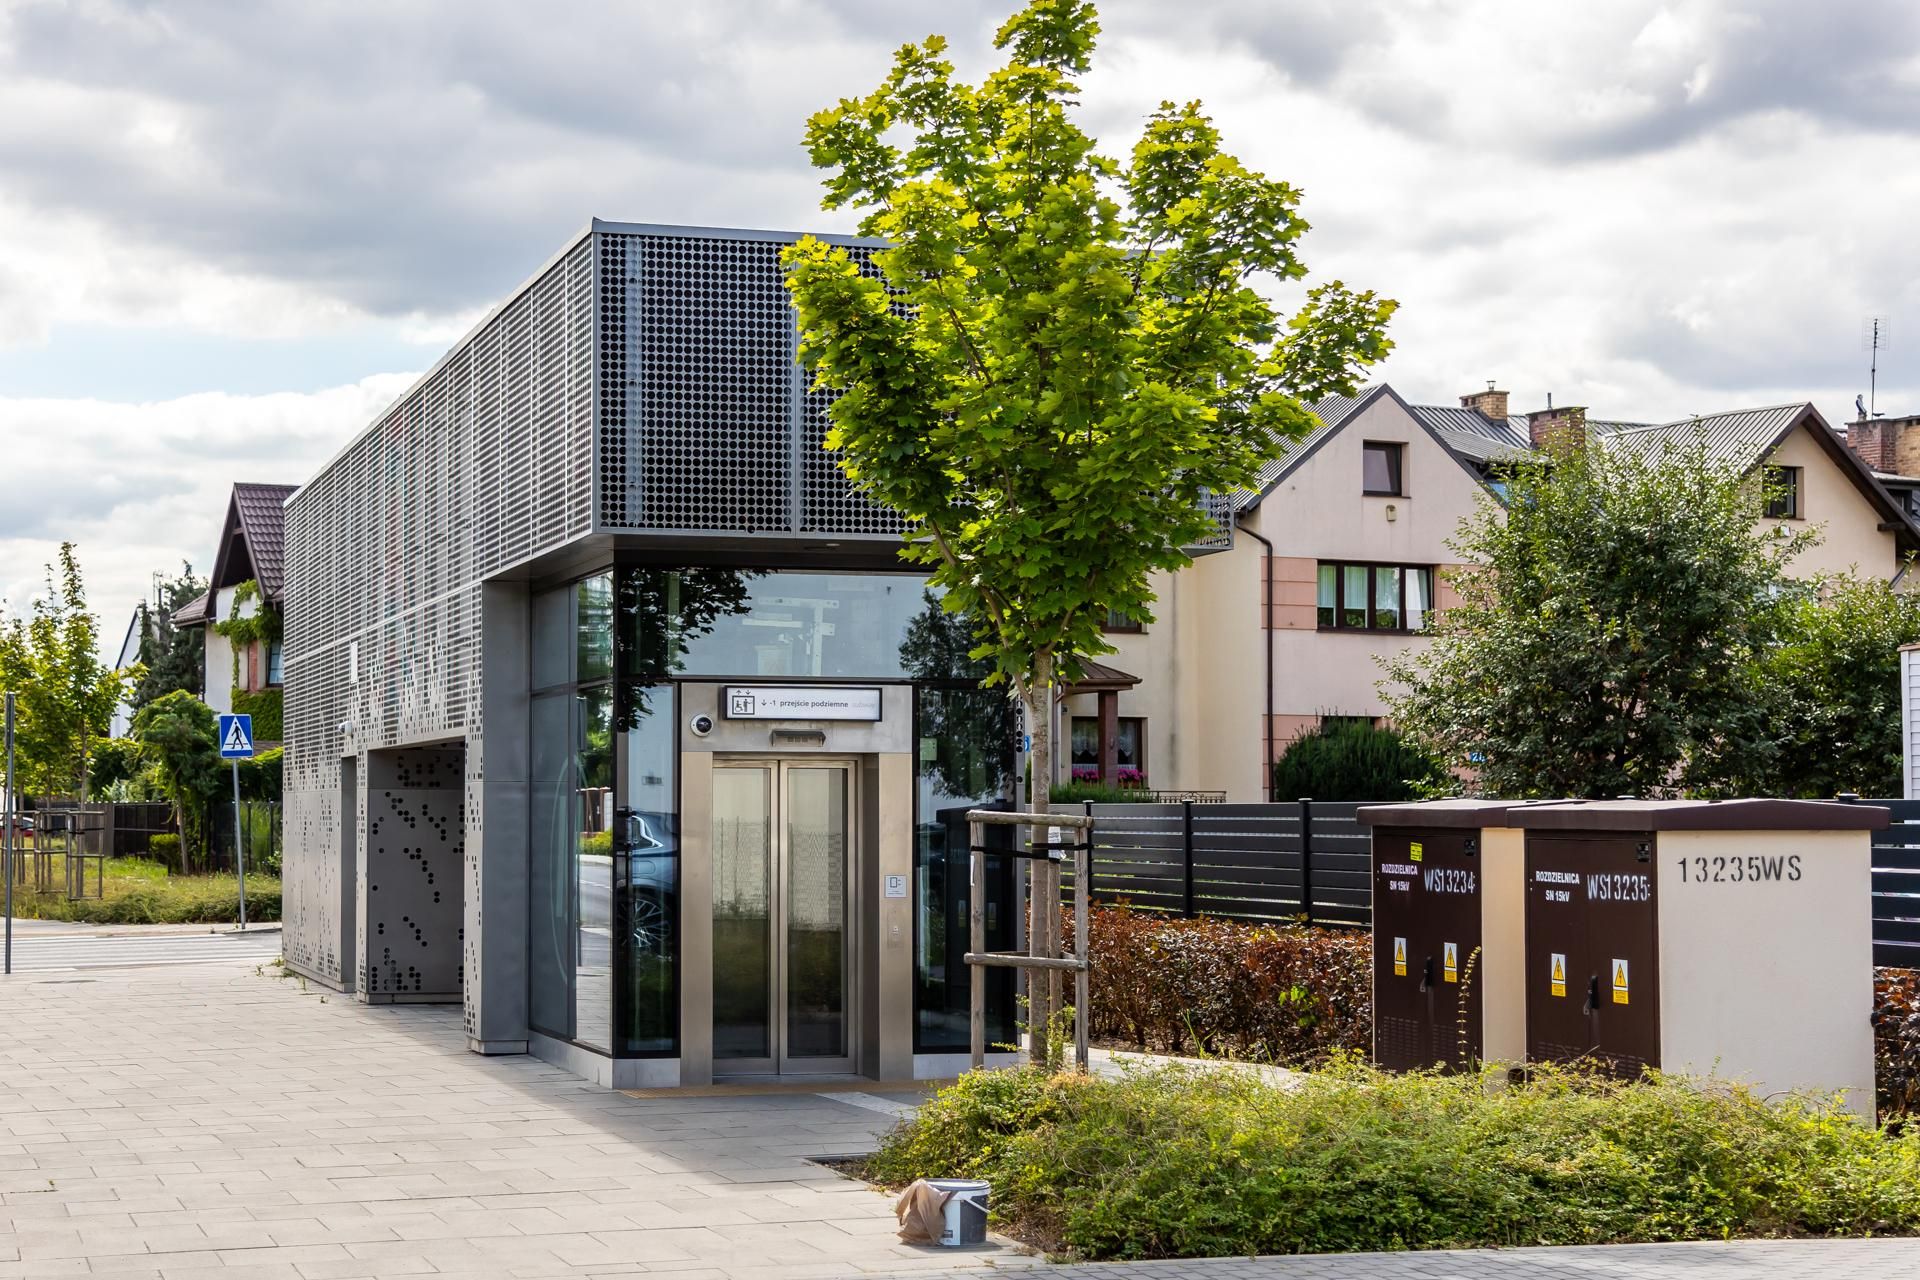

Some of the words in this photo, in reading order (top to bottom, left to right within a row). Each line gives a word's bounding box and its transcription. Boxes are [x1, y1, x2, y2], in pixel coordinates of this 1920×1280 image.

[780, 699, 810, 708] przejście
[811, 700, 849, 708] podziemne
[1381, 863, 1418, 875] ROZDZIELNICA
[1677, 855, 1802, 882] 13235WS
[1424, 867, 1475, 894] WS13234
[1535, 870, 1580, 884] ROZDZIELNICA
[1389, 880, 1398, 891] SN
[1587, 874, 1648, 901] WS13235
[1545, 889, 1555, 901] SN
[1555, 890, 1570, 902] 15kV
